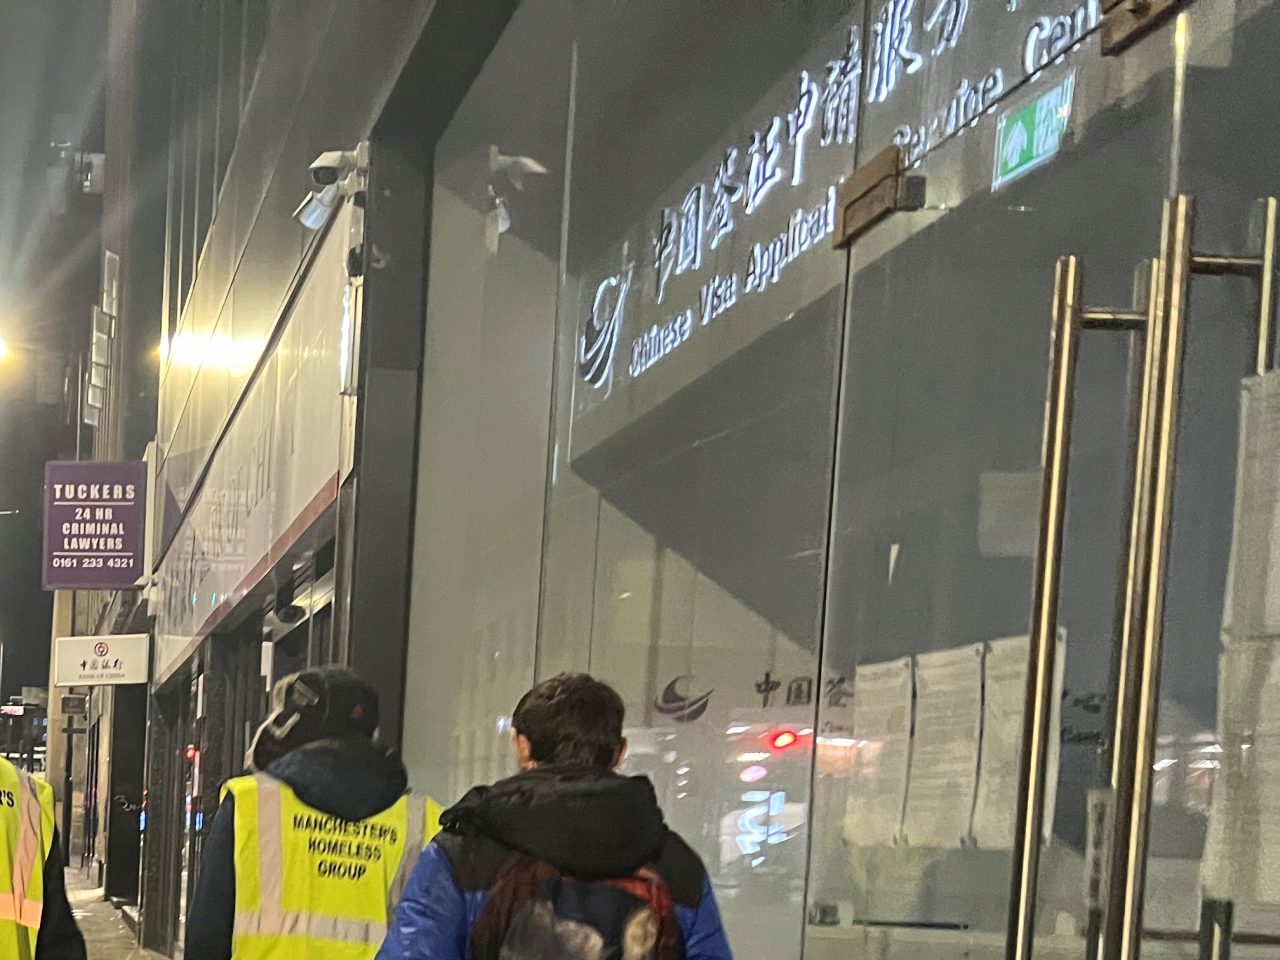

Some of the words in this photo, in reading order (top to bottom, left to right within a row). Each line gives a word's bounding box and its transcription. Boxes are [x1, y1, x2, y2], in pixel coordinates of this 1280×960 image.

[629, 308, 693, 377] Chinese
[699, 273, 737, 326] Visa
[53, 484, 135, 499] TUCKERS
[75, 507, 91, 520] 24
[95, 507, 113, 520] HR
[62, 522, 125, 535] CRIMINAL
[63, 537, 123, 550] LAWYERS
[52, 558, 77, 568] 0161
[82, 558, 103, 568] 233
[107, 558, 134, 568] 4321
[293, 814, 398, 845] MANCHESTER'S
[308, 837, 382, 861] HOMELESS
[318, 859, 366, 879] GROUP
